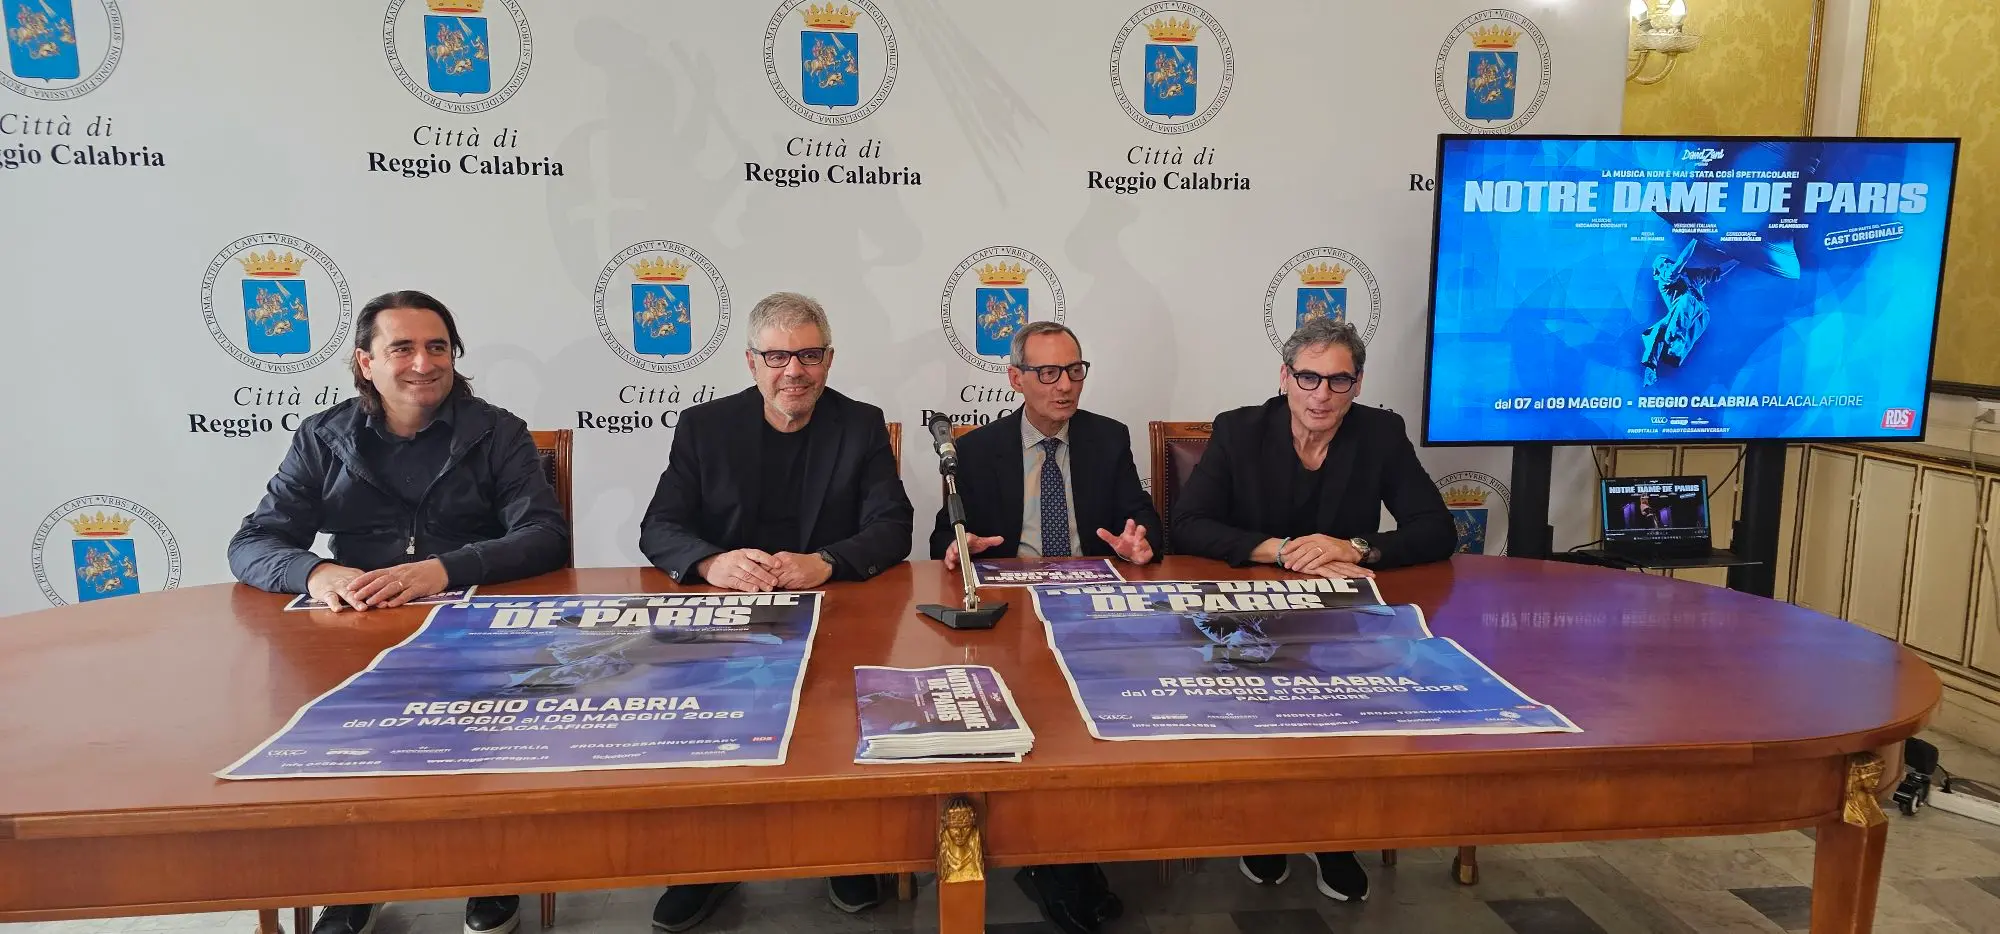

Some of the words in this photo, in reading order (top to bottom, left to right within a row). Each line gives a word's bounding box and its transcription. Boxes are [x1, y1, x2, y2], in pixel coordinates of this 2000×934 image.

[0, 113, 71, 135] Città
[86, 116, 113, 137] di
[413, 125, 480, 147] Città
[493, 128, 518, 148] di
[51, 143, 165, 167] Calabria
[786, 137, 847, 158] Città
[859, 139, 881, 158] di
[1127, 146, 1183, 165] Città
[1194, 147, 1215, 165] di
[367, 152, 451, 179] Reggio
[459, 154, 564, 176] Calabria
[744, 163, 819, 187] Reggio
[827, 164, 922, 185] Calabria
[1602, 170, 1611, 178] LA
[1613, 170, 1645, 178] MUSICA
[1088, 171, 1157, 194] Reggio
[1163, 172, 1250, 190] Calabria
[1463, 180, 1597, 212] NOTRE
[1613, 181, 1728, 213] DAME
[1743, 182, 1791, 213] DE
[1804, 182, 1928, 213] PARIS
[1824, 234, 1850, 246] CAST
[1852, 226, 1904, 242] ORIGINALE
[234, 385, 302, 406] Città
[314, 386, 338, 406] di
[619, 385, 681, 404] Città
[693, 385, 716, 403] di
[1494, 398, 1512, 409] dal
[1514, 398, 1532, 409] 07
[1534, 398, 1544, 409] al
[1546, 398, 1564, 409] 09
[1568, 397, 1622, 409] MAGGIO
[1638, 396, 1688, 408] REGGIO
[1690, 396, 1758, 408] CALABRIA
[1762, 396, 1863, 407] PALACALAFIORE
[188, 413, 273, 438] Reggio
[576, 410, 653, 433] Reggio
[1885, 409, 1909, 425] RDS
[1091, 594, 1155, 612] DE
[1167, 594, 1327, 613] PARIS
[489, 608, 565, 628] DE
[577, 607, 752, 628] PARIS
[927, 678, 950, 691] DE
[946, 669, 976, 700] NOTRE
[1158, 676, 1266, 687] REGGIO
[1271, 676, 1420, 687] CALABRIA
[1184, 688, 1268, 696] MAGGIO
[402, 700, 529, 715] REGGIO
[535, 696, 700, 712] CALABRIA
[931, 691, 962, 721] PARIS
[957, 700, 990, 729] DAME
[342, 719, 376, 728] dal
[379, 717, 415, 727] 07
[418, 716, 517, 726] MAGGIO
[544, 714, 580, 722] 09
[582, 712, 677, 722] MAGGIO
[683, 711, 744, 720] 2026
[464, 723, 619, 732] PALACALAFIORE
